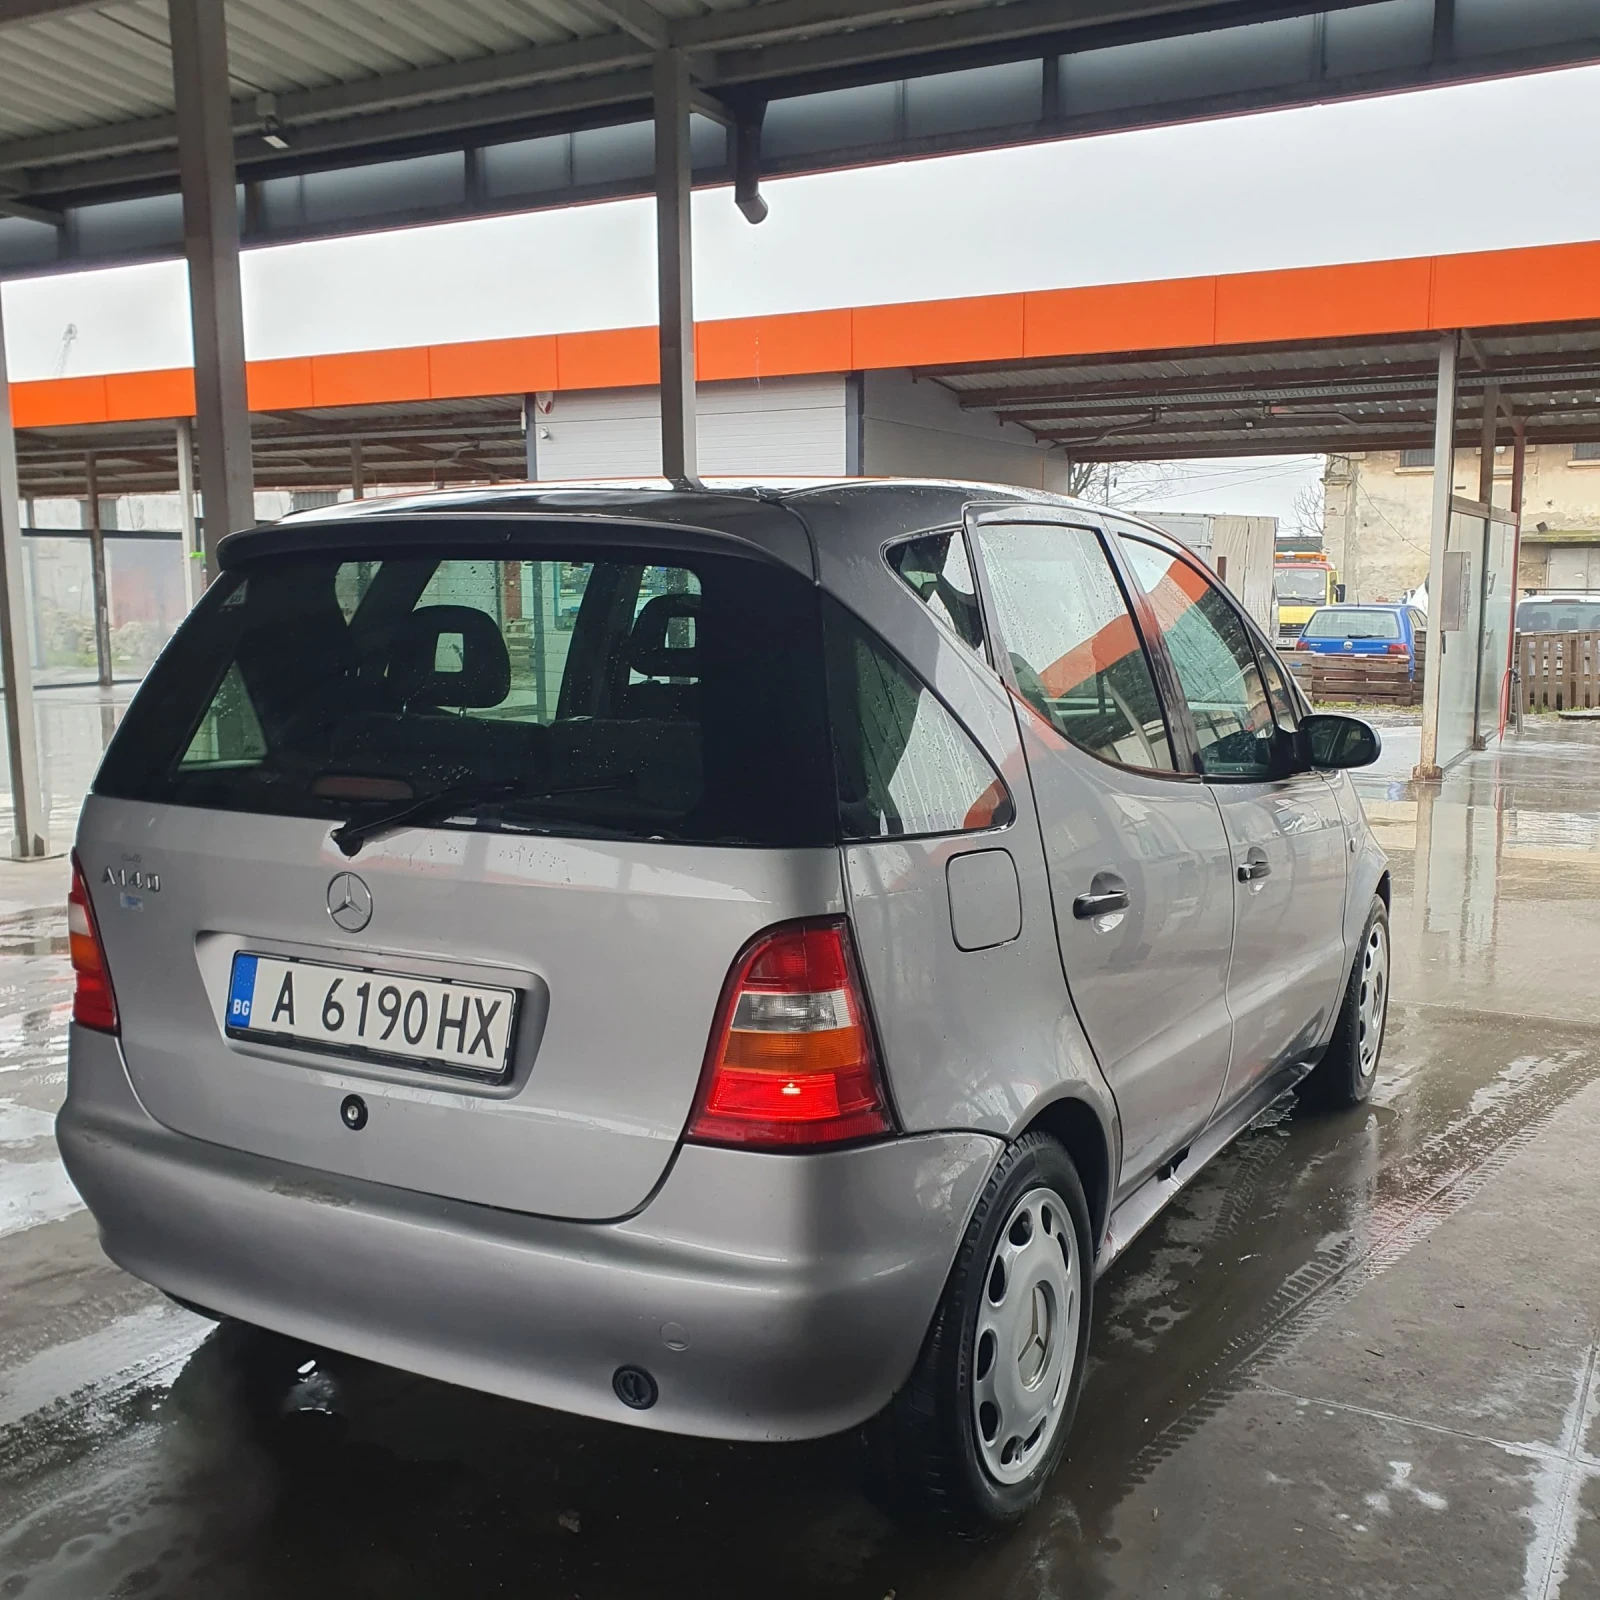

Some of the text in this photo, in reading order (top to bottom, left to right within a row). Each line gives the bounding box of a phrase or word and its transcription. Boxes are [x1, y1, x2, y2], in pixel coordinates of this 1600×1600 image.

[101, 866, 161, 892] A140
[231, 998, 251, 1017] BG
[271, 970, 295, 1026] A
